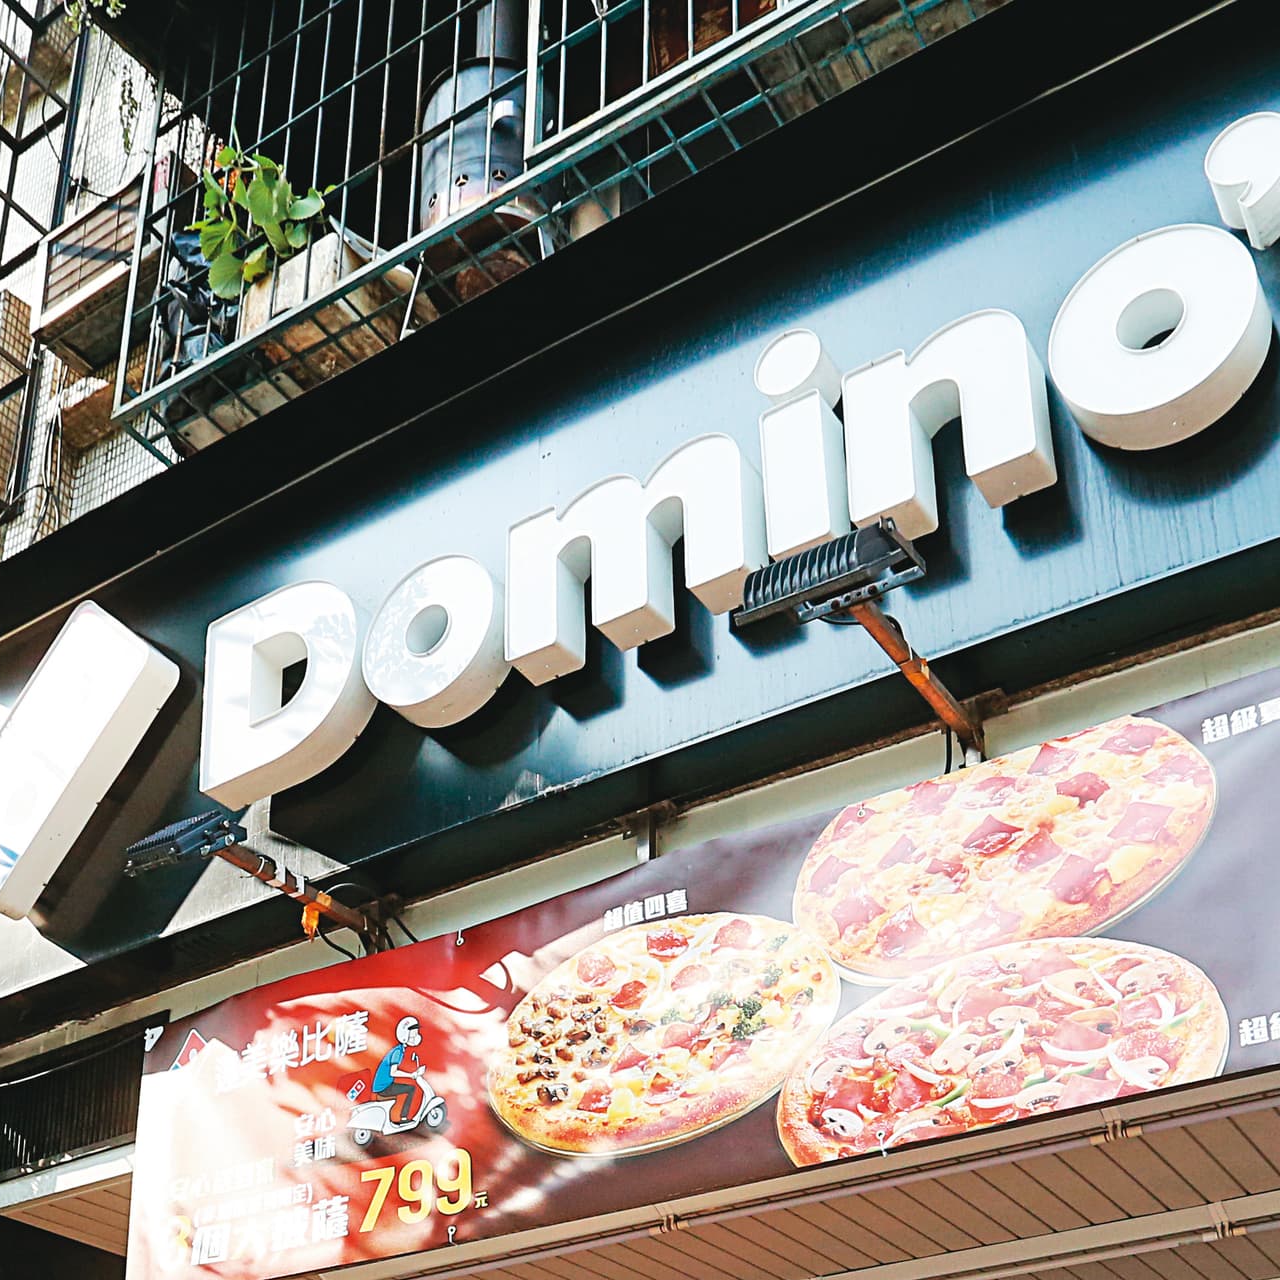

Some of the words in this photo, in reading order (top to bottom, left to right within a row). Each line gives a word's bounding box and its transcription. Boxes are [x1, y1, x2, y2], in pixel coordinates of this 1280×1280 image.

[604, 889, 687, 931] 超值四喜
[217, 1010, 370, 1089] 美樂比薩
[293, 1108, 336, 1138] 安心
[293, 1136, 336, 1168] 美味
